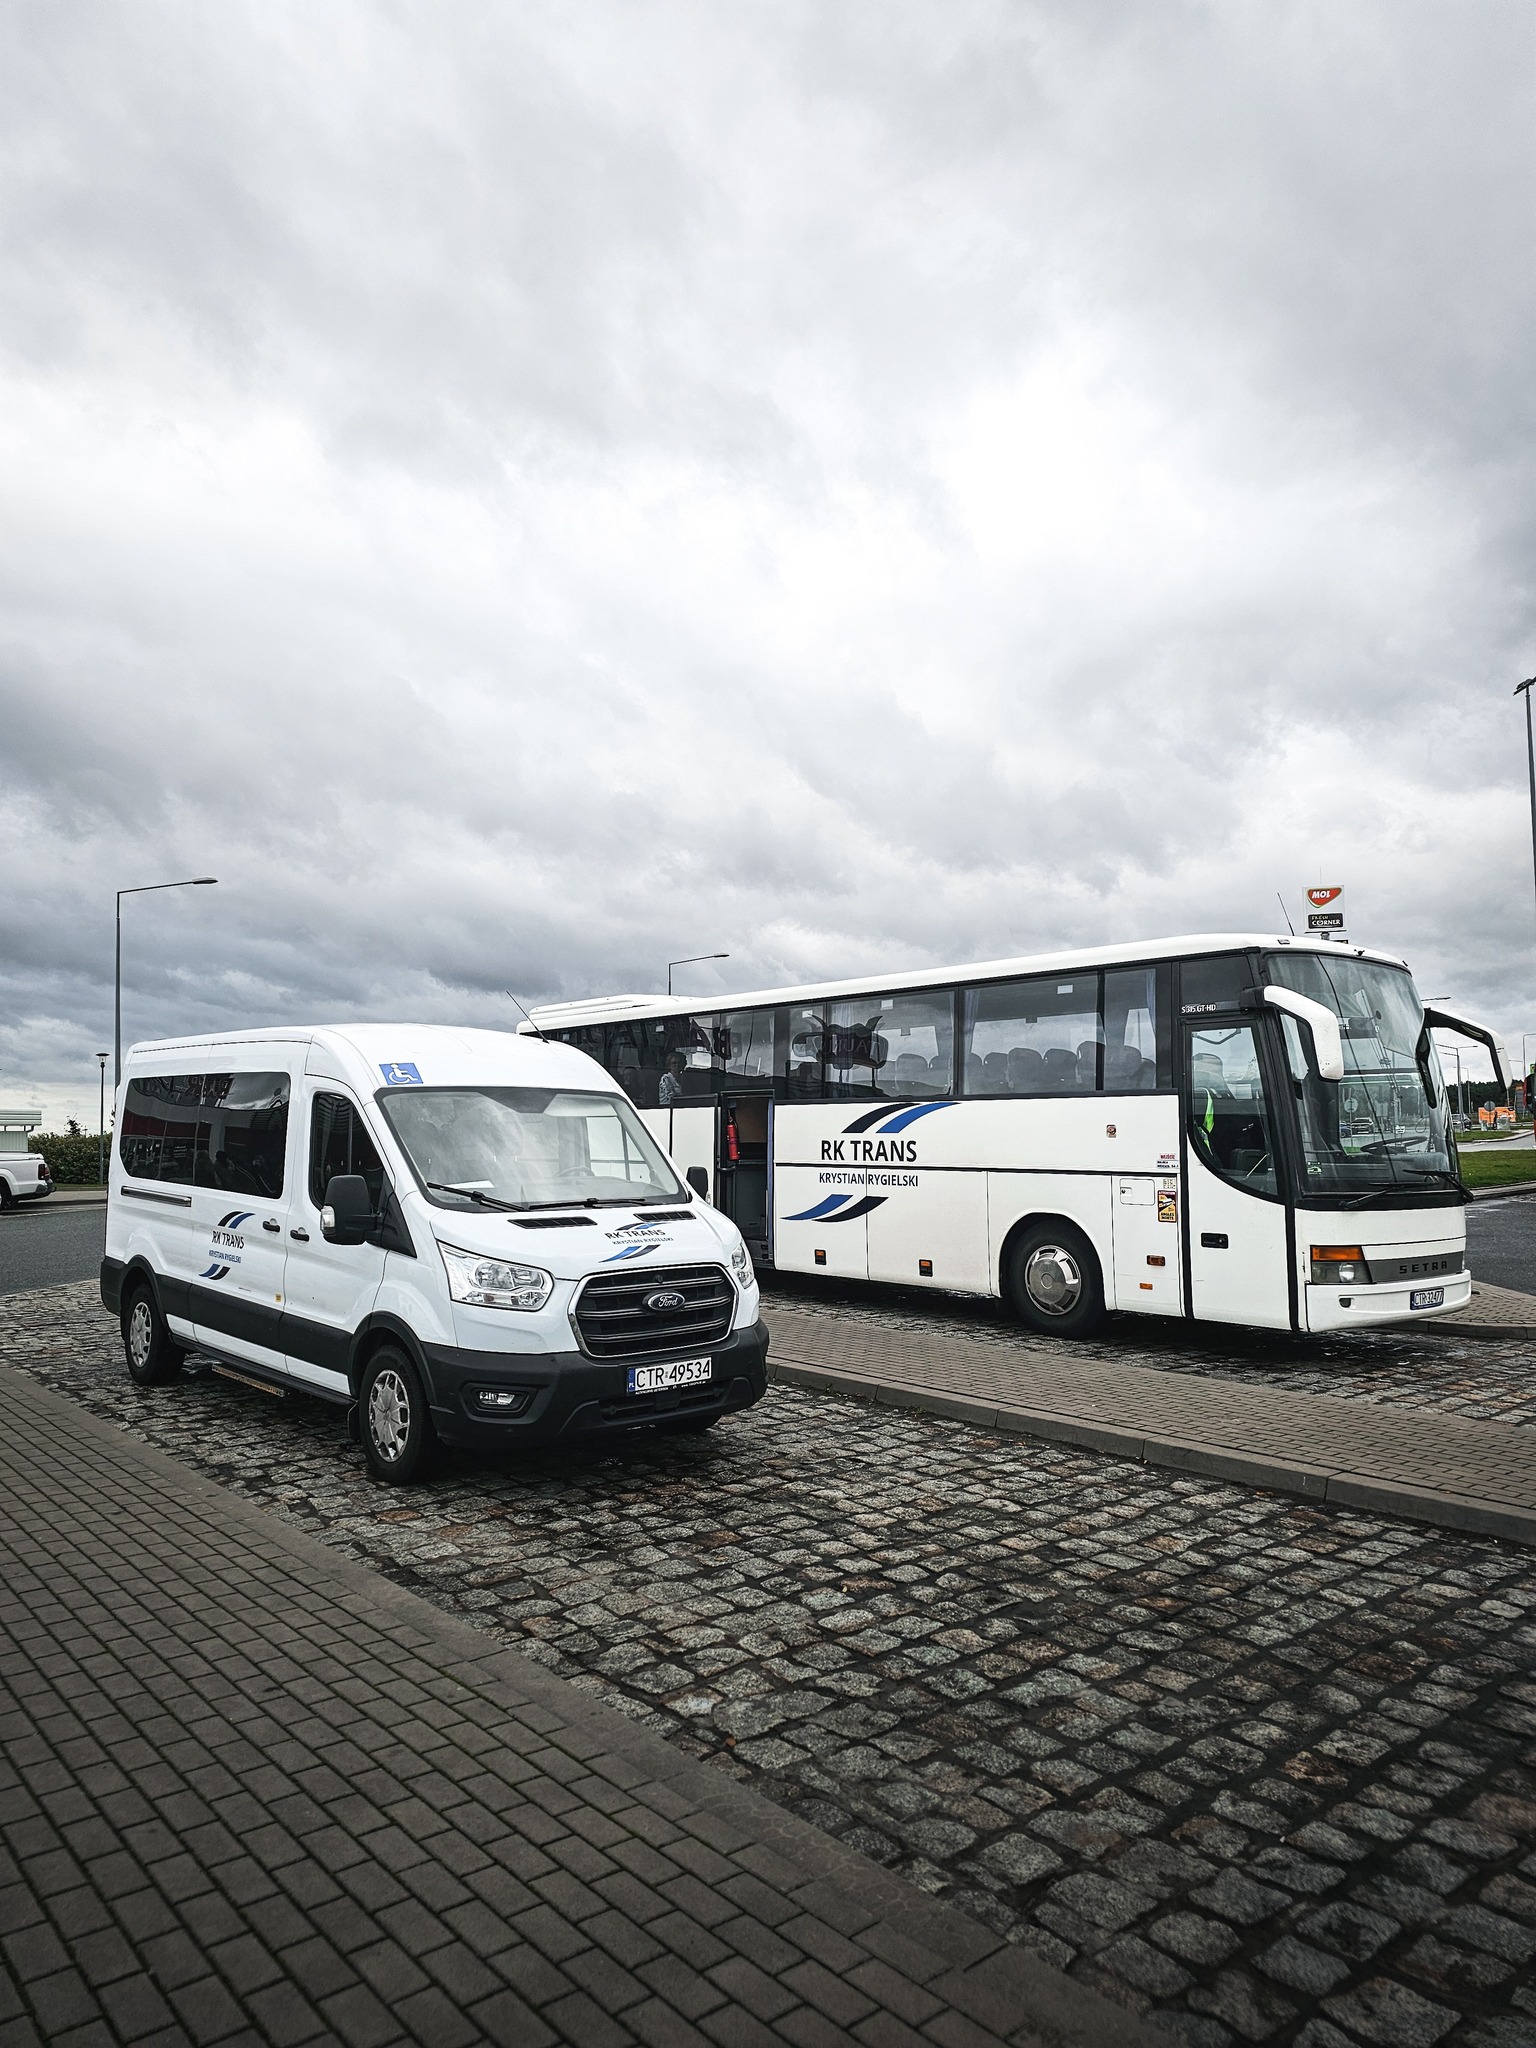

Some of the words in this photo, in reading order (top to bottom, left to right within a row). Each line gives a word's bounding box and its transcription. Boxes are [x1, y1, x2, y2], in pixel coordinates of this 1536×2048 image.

[1312, 890, 1331, 898] MOL
[821, 1140, 845, 1161] RK
[850, 1140, 917, 1162] TRANS
[819, 1172, 865, 1185] KRYSTIAN
[868, 1174, 918, 1187] RYGIELSKI
[211, 1230, 221, 1244] RK
[222, 1233, 245, 1249] TRANS
[604, 1230, 625, 1240] RK
[625, 1229, 666, 1239] TRANS
[1399, 1261, 1448, 1274] SETRA
[658, 1295, 678, 1308] Ford
